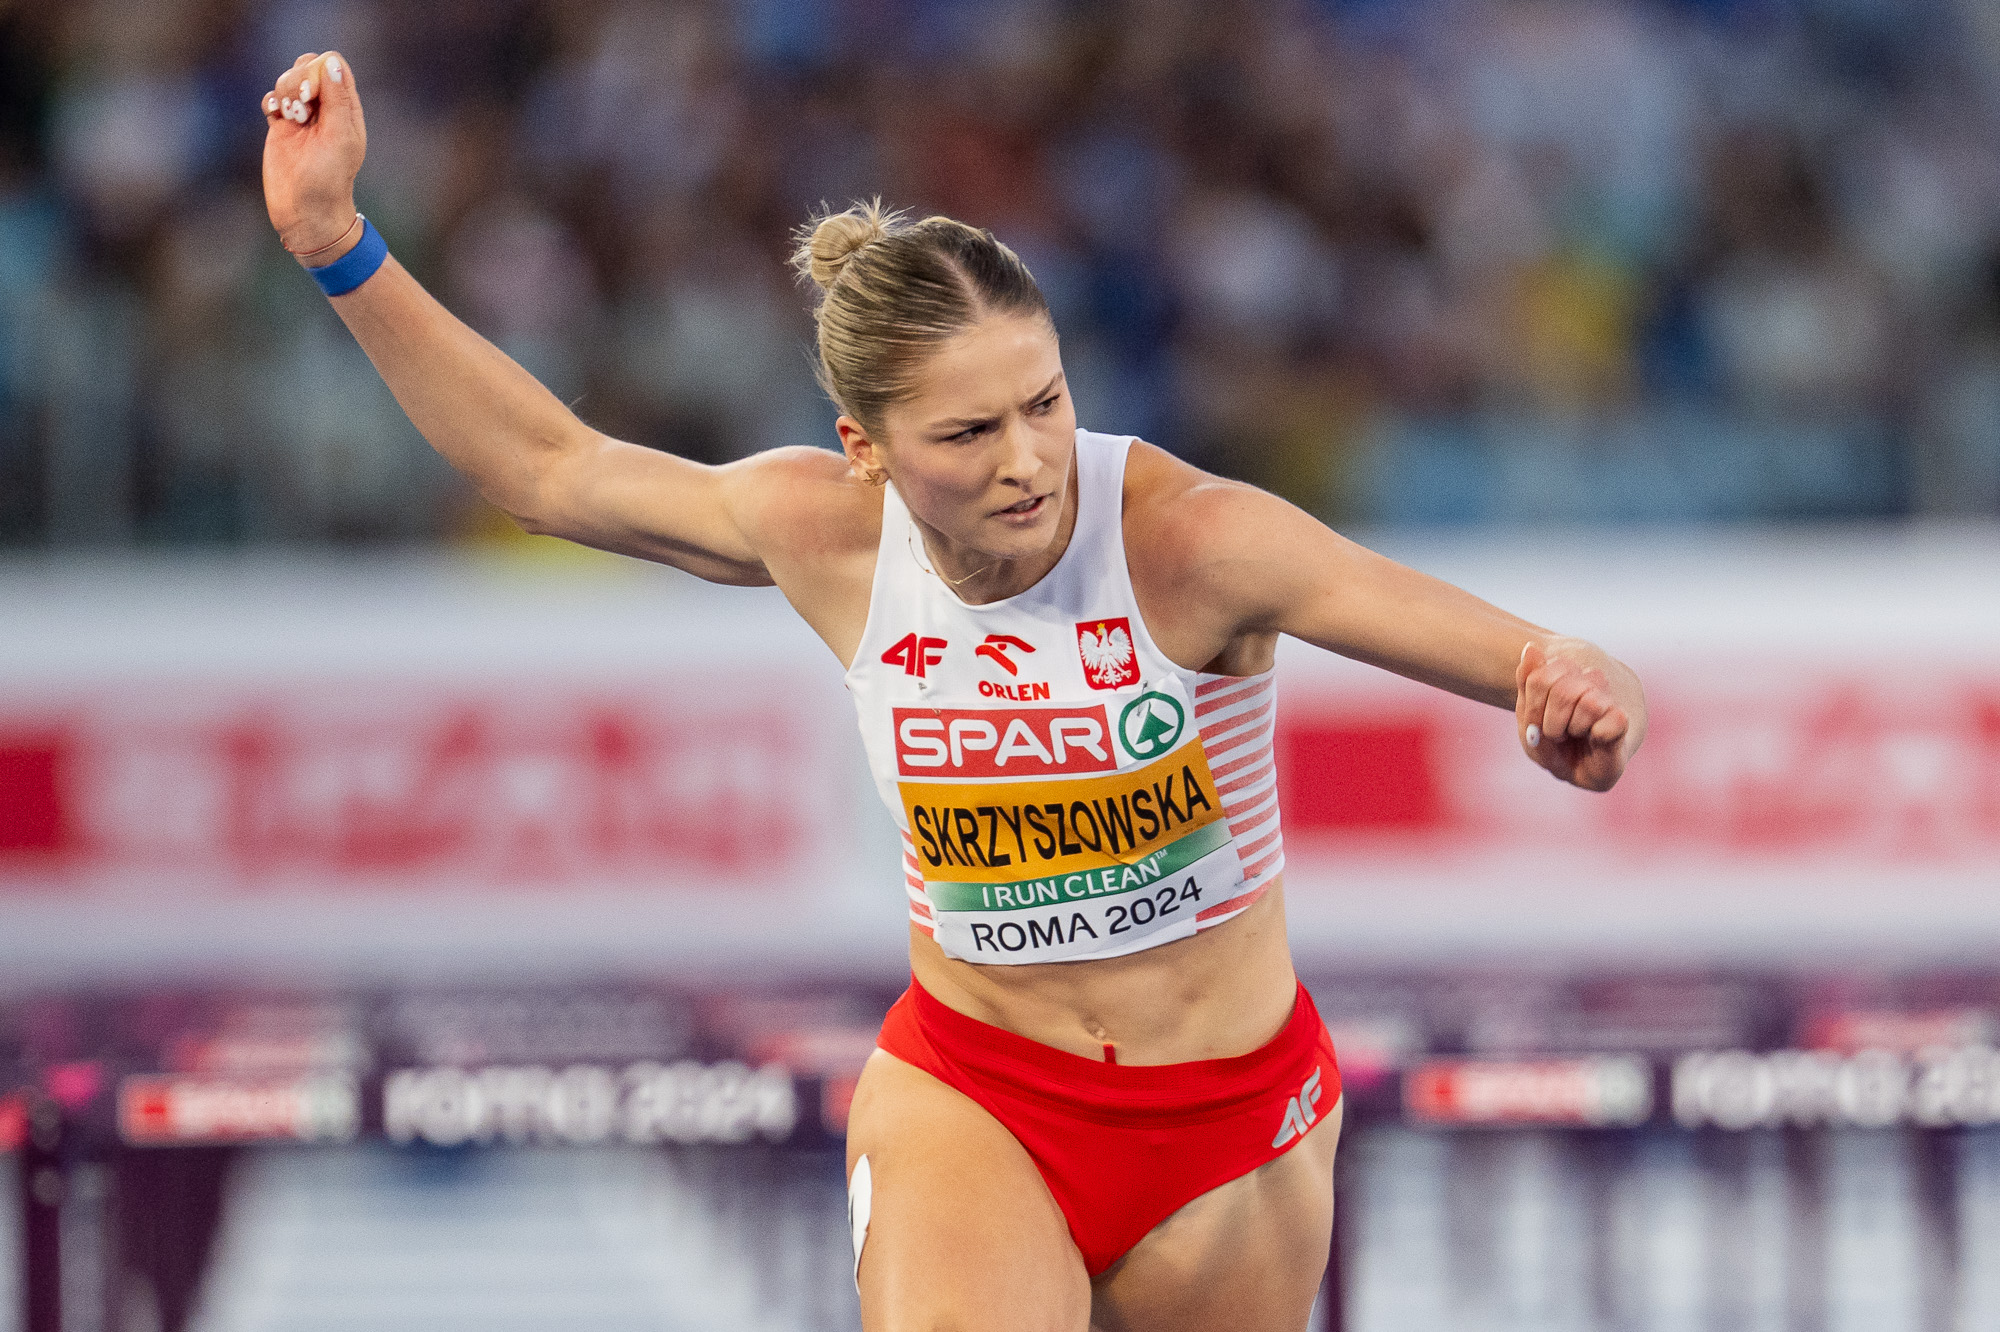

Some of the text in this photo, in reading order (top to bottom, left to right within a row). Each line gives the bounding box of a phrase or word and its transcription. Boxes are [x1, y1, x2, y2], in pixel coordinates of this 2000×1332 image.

[881, 633, 947, 677] 4F
[978, 680, 1050, 700] ORLEN
[902, 718, 1108, 767] SPAR
[914, 765, 1211, 866] SKRZYSZOWSKA
[971, 876, 1203, 953] ROMA 2024
[982, 887, 991, 908] I
[996, 878, 1058, 907] RUN
